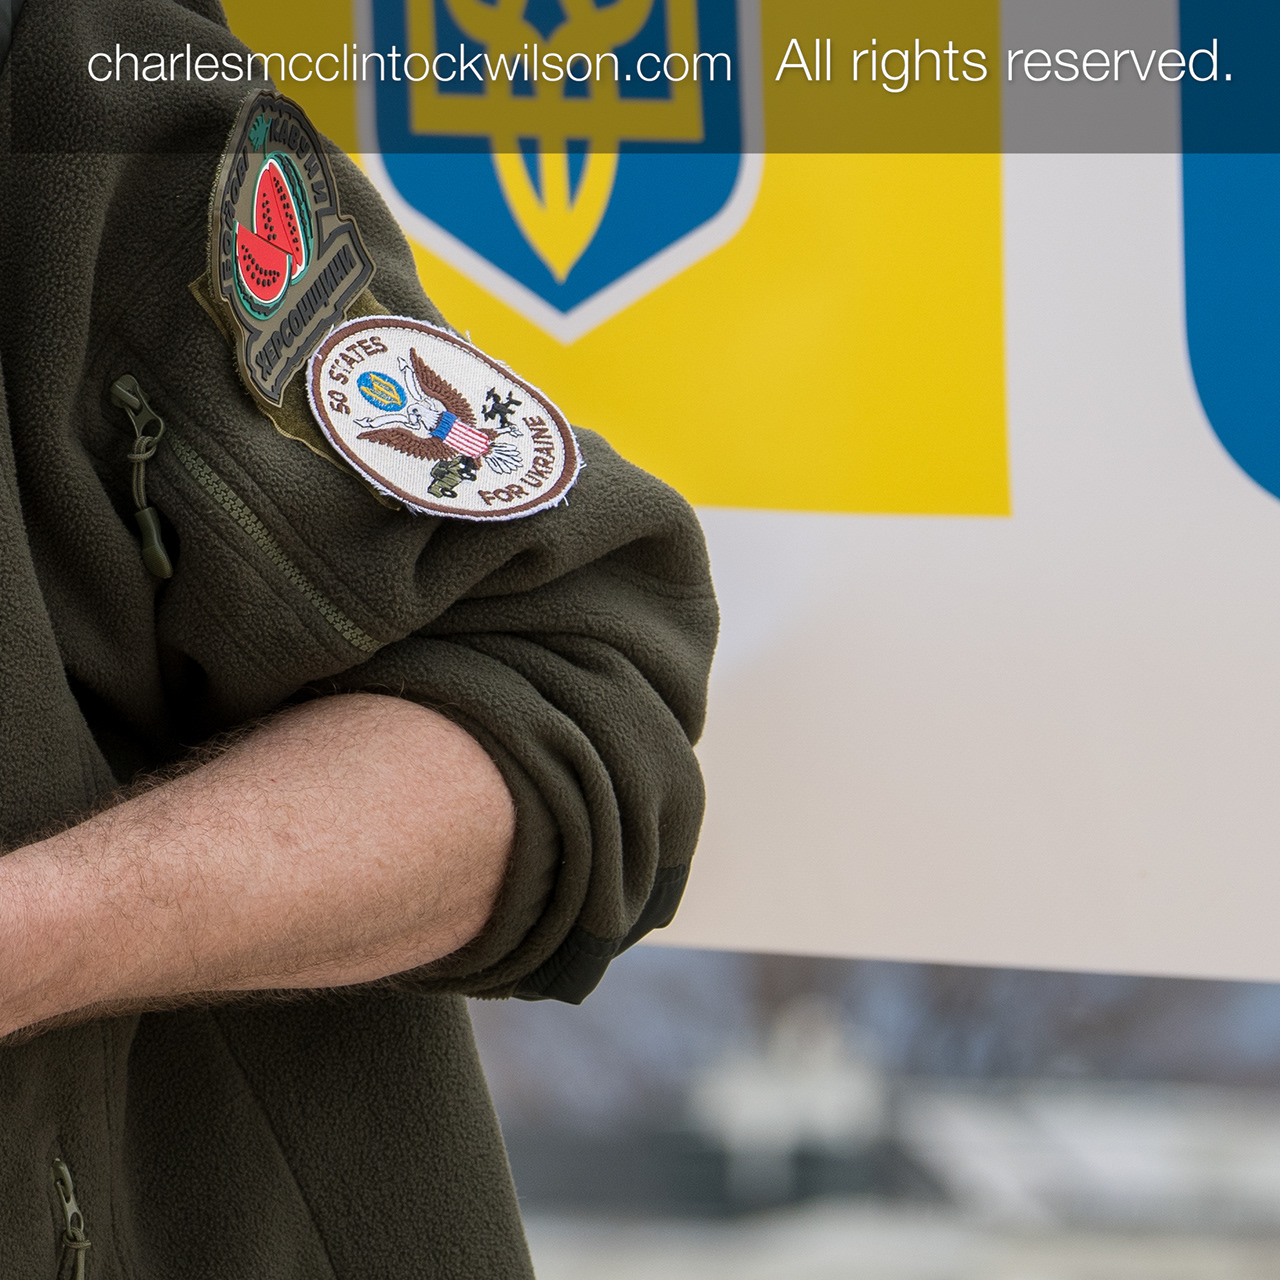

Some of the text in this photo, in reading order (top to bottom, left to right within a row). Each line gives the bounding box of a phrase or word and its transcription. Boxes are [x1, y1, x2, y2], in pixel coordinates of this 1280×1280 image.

[327, 336, 388, 415] 50 STATES
[478, 415, 555, 506] FOR UKRAINE
